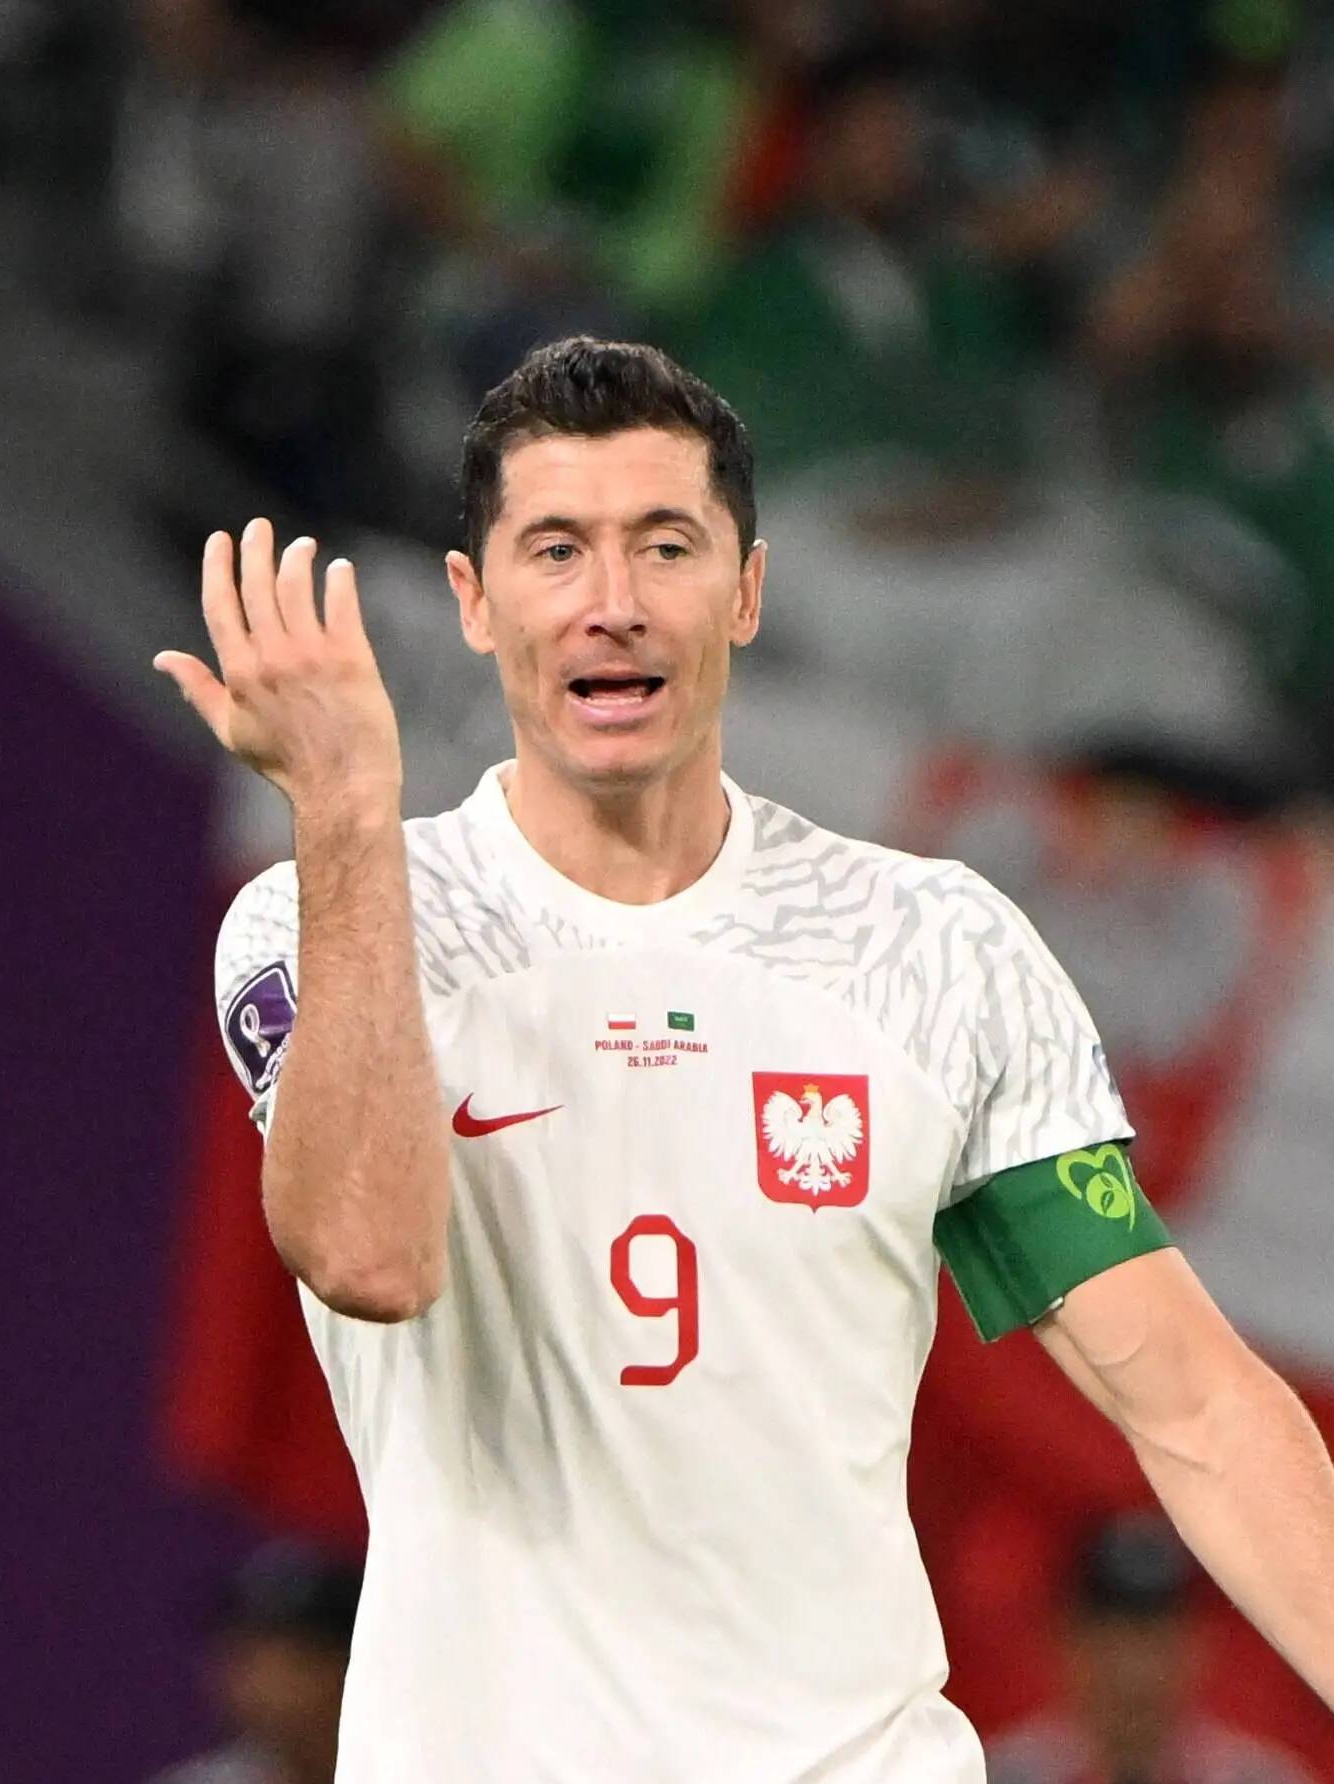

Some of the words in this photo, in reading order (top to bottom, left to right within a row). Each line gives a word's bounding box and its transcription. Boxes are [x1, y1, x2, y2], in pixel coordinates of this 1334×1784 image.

[595, 1040, 633, 1051] POLAND
[643, 1039, 671, 1051] SAUDI
[673, 1040, 708, 1052] ARABIA
[627, 1055, 677, 1067] 26.11.2022
[610, 1214, 699, 1386] 9
